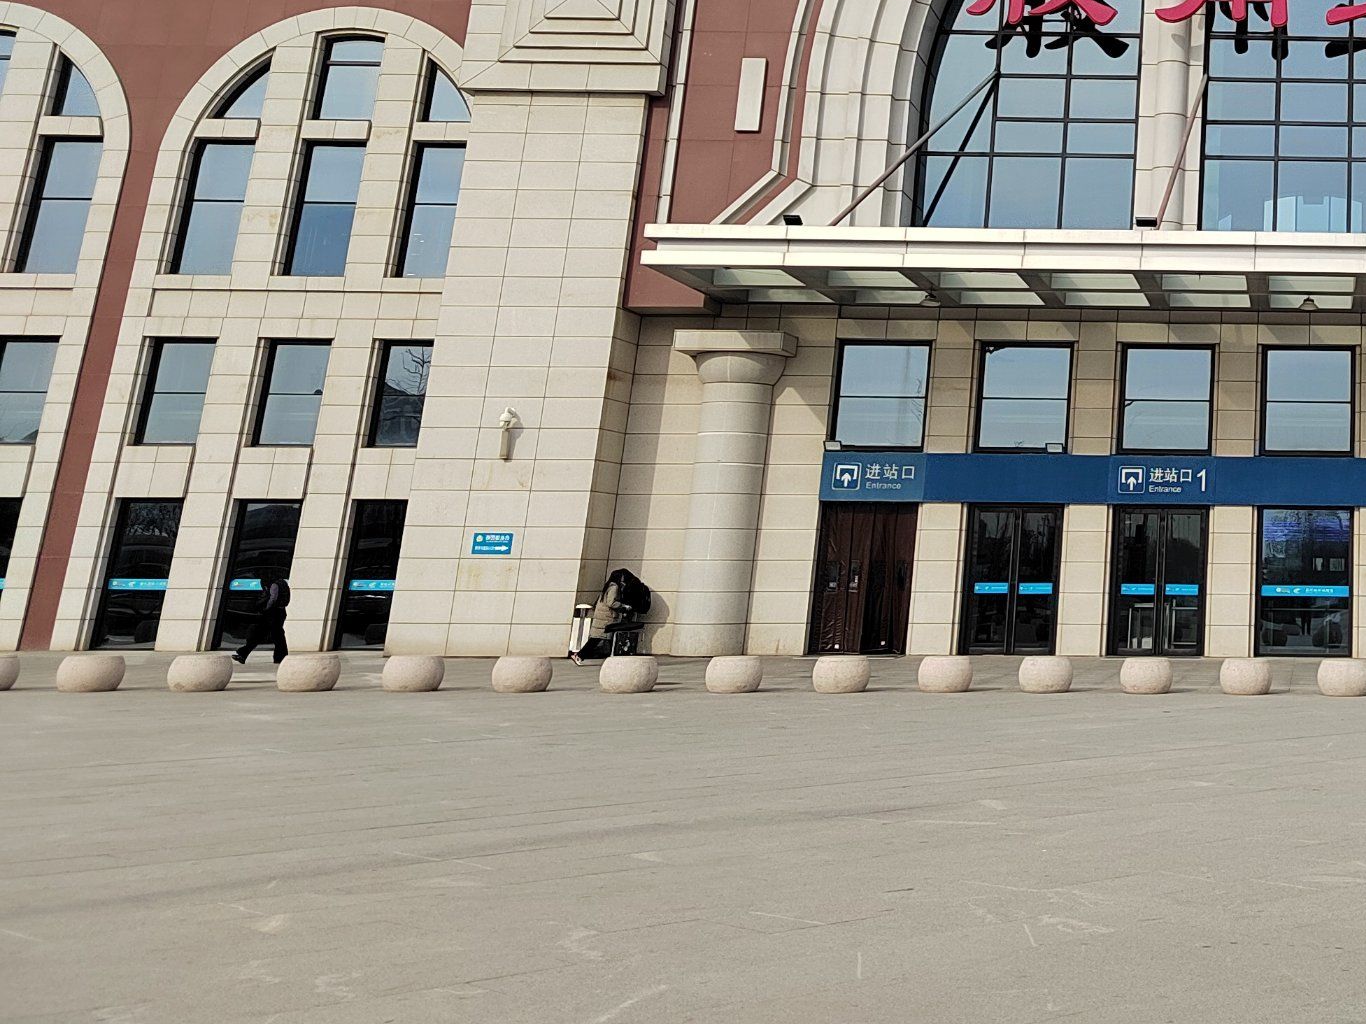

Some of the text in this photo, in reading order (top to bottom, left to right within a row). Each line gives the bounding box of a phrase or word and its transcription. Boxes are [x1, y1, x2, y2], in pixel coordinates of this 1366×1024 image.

[865, 463, 915, 479] 进站口
[1149, 468, 1206, 492] 进站口 1
[1149, 485, 1181, 493] Entrance
